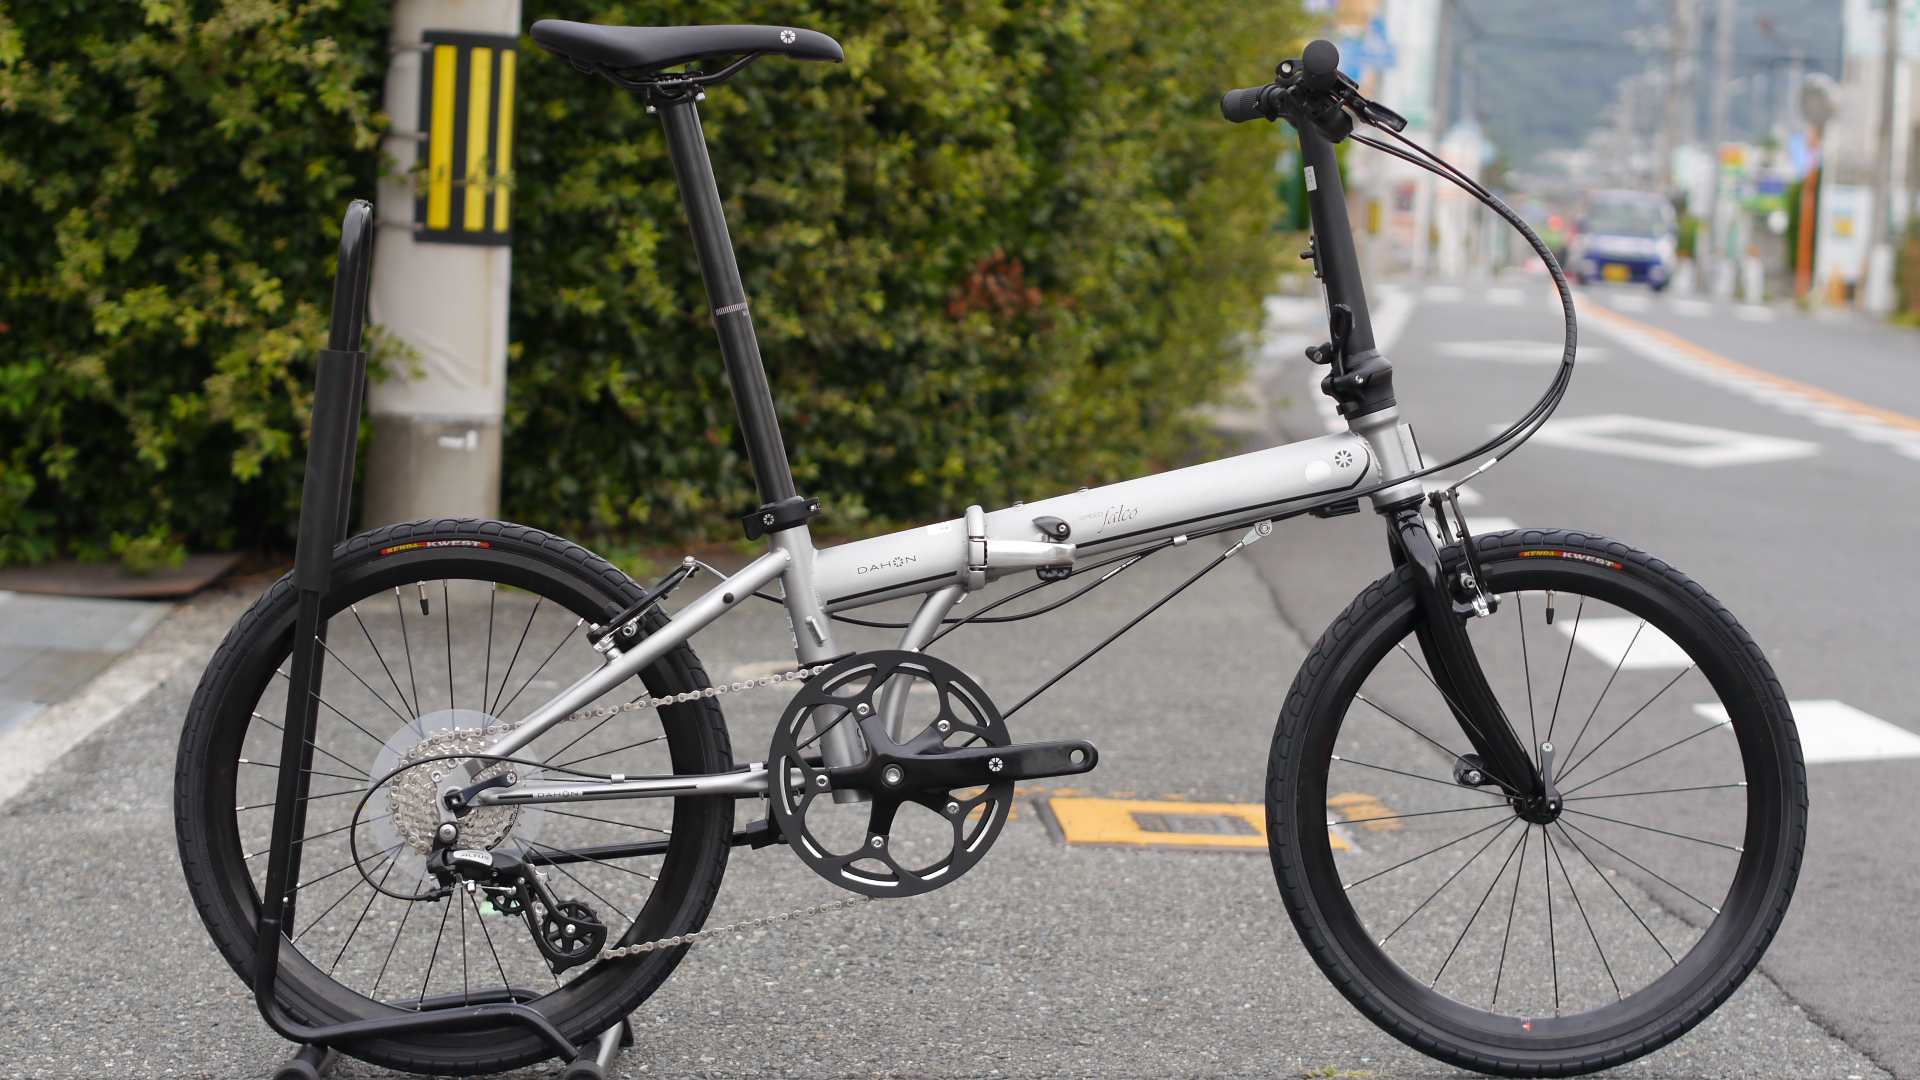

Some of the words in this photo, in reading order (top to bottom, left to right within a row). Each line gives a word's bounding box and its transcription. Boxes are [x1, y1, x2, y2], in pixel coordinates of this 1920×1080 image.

[1097, 504, 1138, 534] falco
[387, 543, 418, 554] KENDA
[857, 555, 917, 575] DAHON
[1562, 552, 1614, 567] KWEST
[537, 790, 579, 798] DAHON
